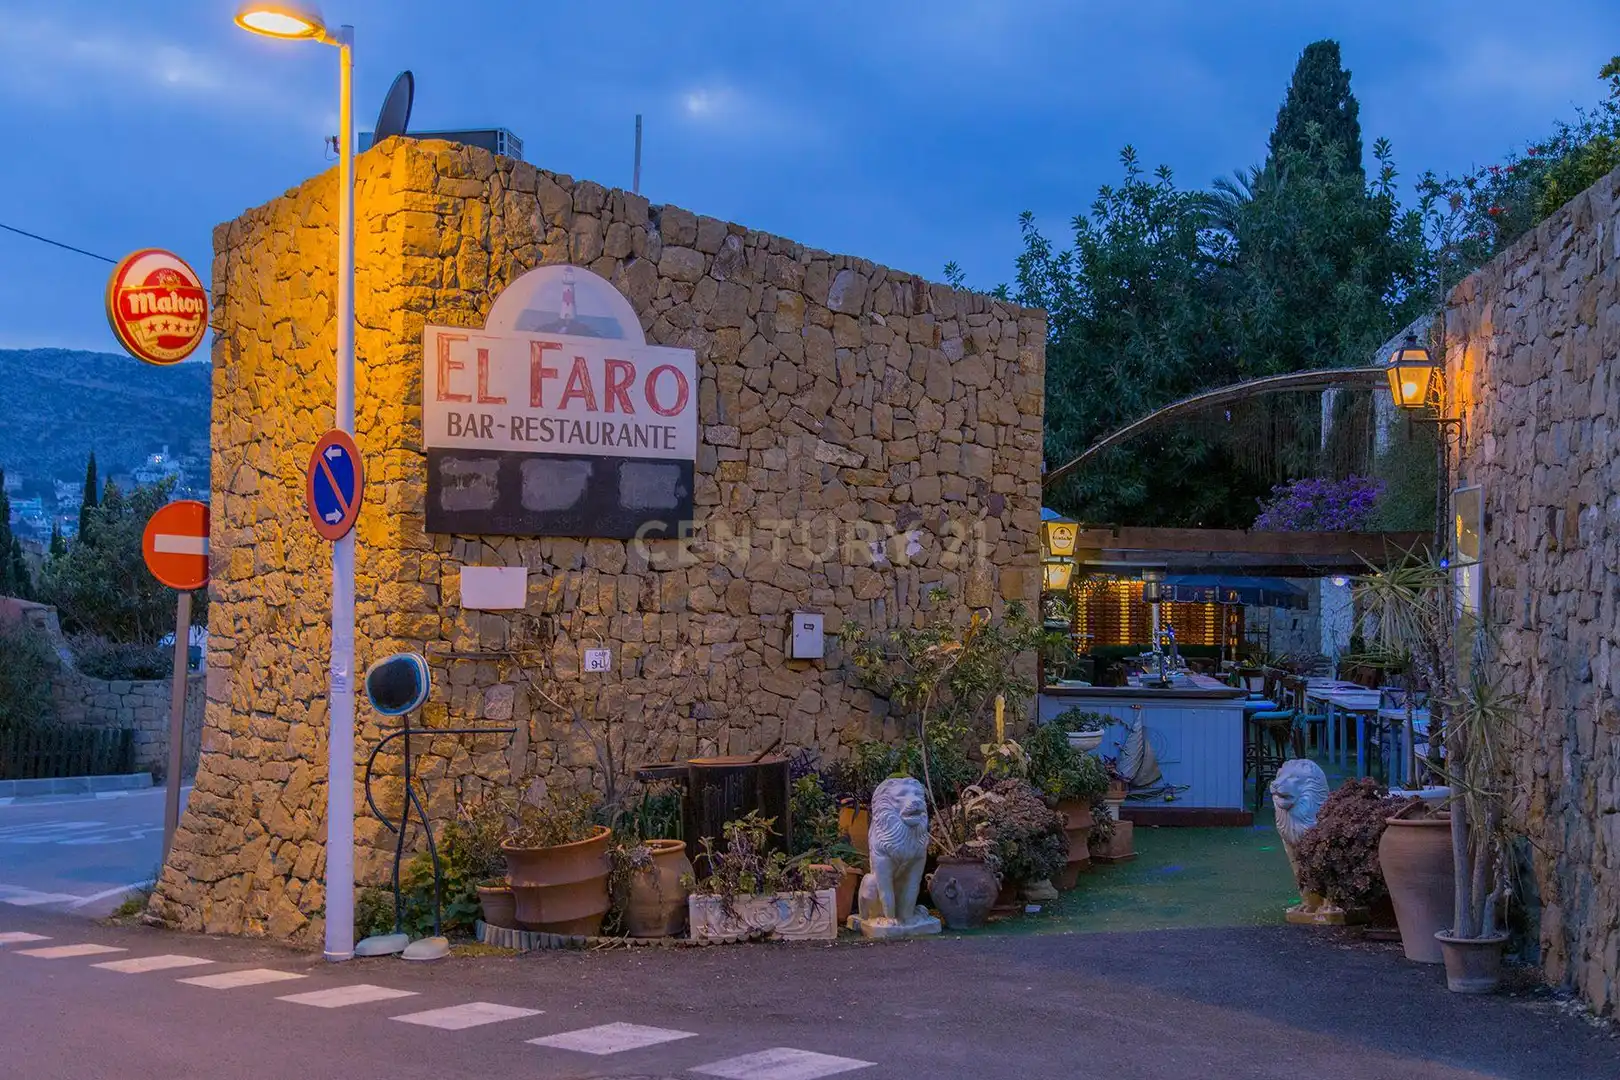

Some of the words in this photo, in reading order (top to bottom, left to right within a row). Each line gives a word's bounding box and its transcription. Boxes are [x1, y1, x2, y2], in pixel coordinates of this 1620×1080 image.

[128, 292, 204, 314] Mahou
[436, 332, 507, 404] EL
[529, 340, 689, 417] FARO
